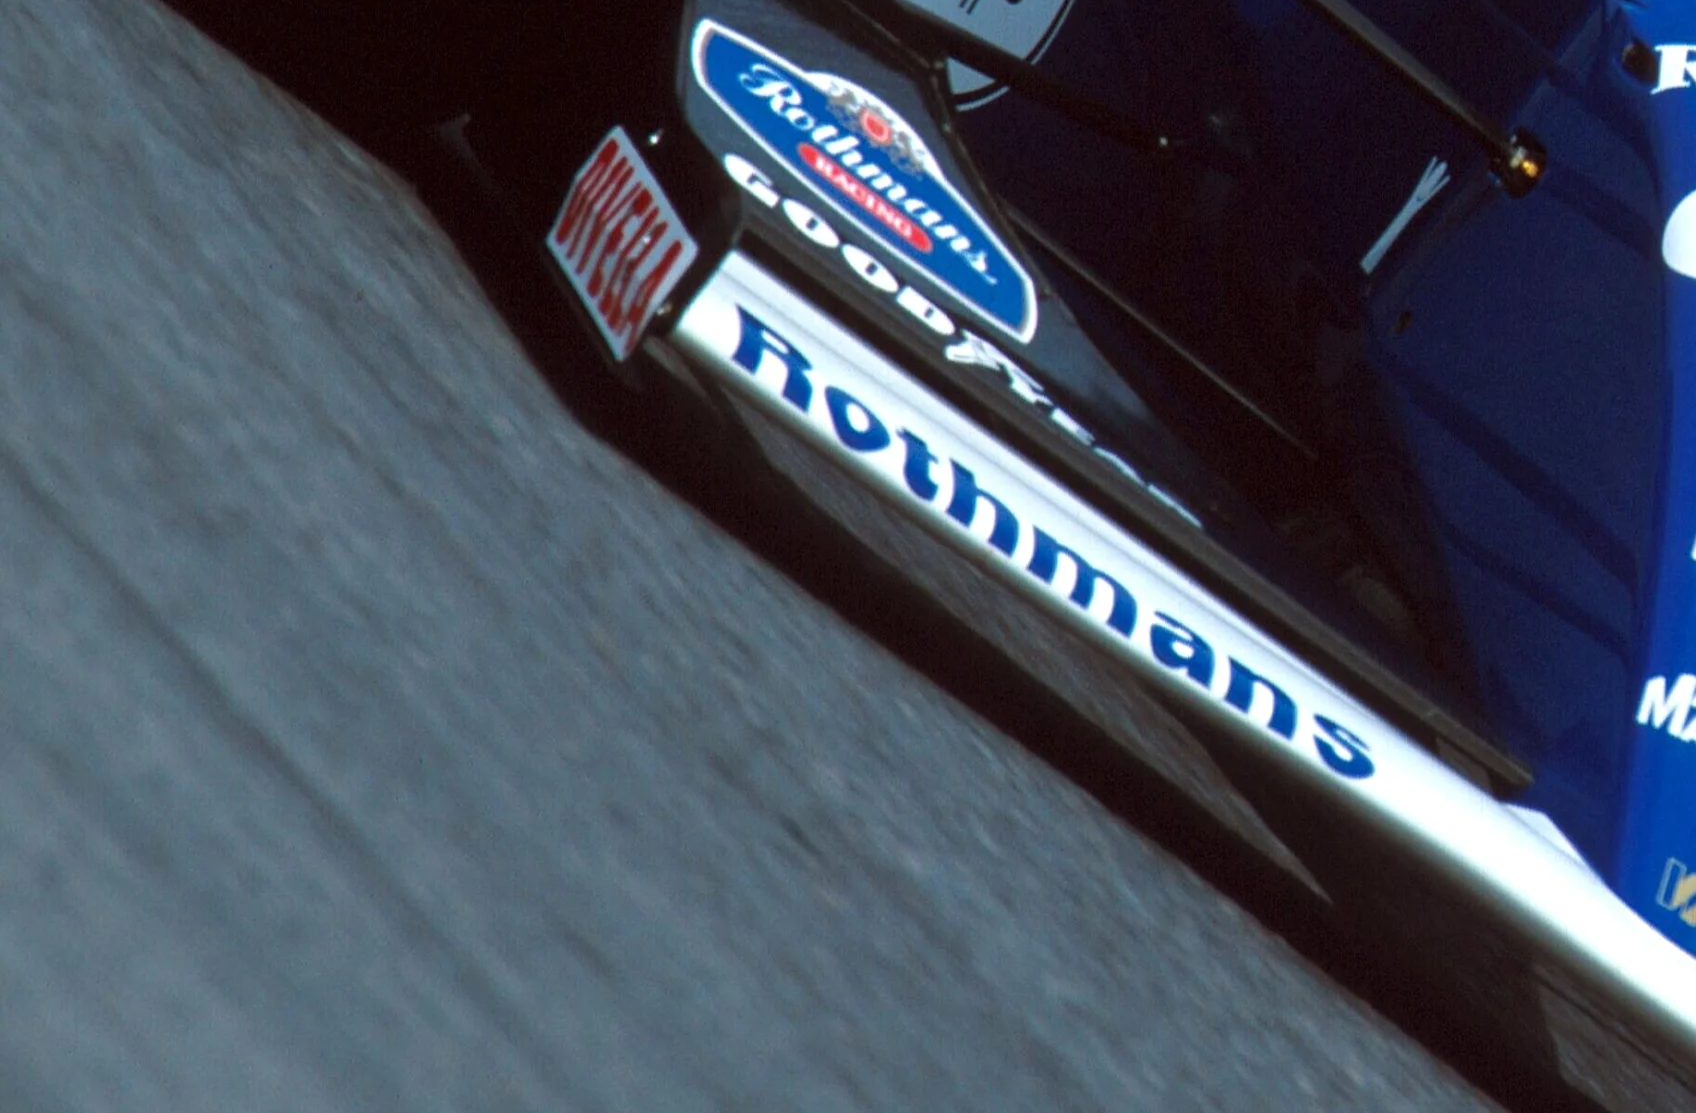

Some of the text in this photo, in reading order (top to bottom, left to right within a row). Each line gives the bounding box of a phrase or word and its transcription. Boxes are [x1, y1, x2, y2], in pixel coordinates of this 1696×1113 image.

[737, 63, 998, 286] Rothmans
[812, 154, 916, 240] RACING
[732, 304, 1376, 780] Rothmans
